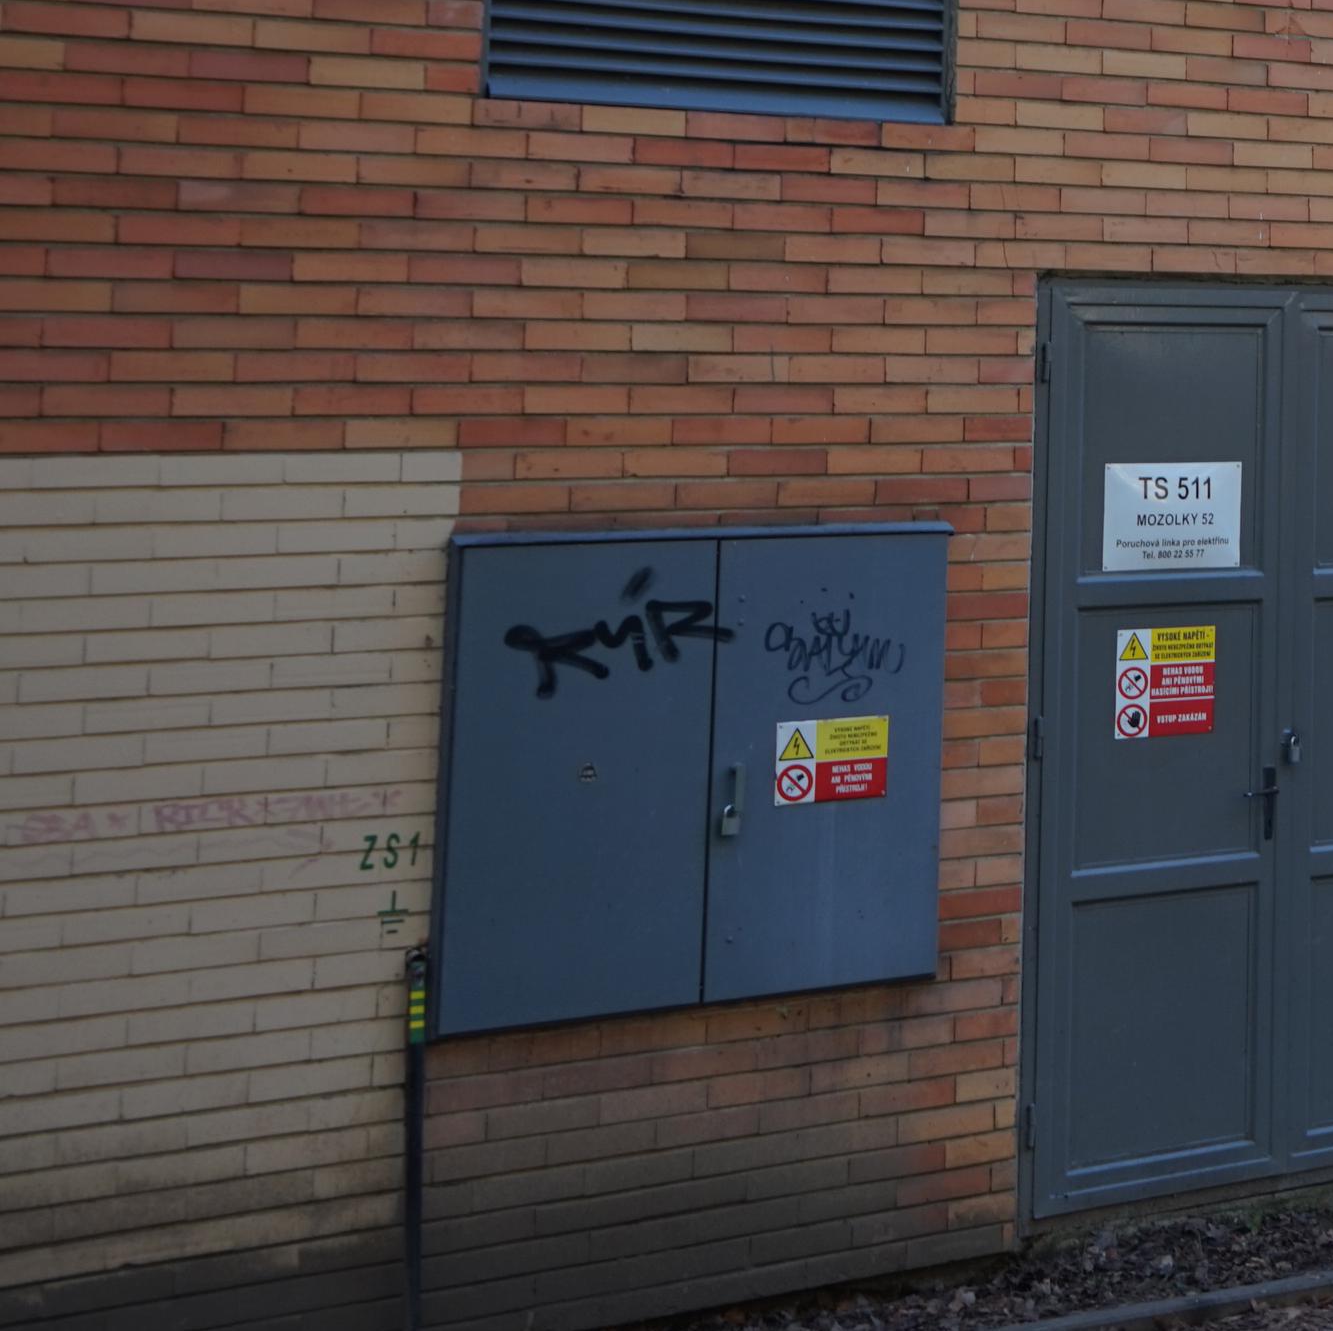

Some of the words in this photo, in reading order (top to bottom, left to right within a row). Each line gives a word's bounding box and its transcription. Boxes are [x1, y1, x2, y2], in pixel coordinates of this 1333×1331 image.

[1138, 476, 1169, 500] TS
[1178, 476, 1211, 500] 511
[1136, 513, 1198, 526] MOZOLKY
[1201, 513, 1214, 525] 52
[1116, 538, 1160, 548] Poruchová
[1161, 538, 1180, 548] linka
[1182, 540, 1195, 548] pro
[1142, 551, 1155, 559] Tel.
[1173, 550, 1183, 558] 22
[1196, 549, 1205, 558] 77
[1157, 631, 1181, 642] VYSOKÉ
[1183, 630, 1206, 640] NAPĚTÍ
[1156, 715, 1177, 724] VSTUP
[360, 831, 421, 870] ZS1
